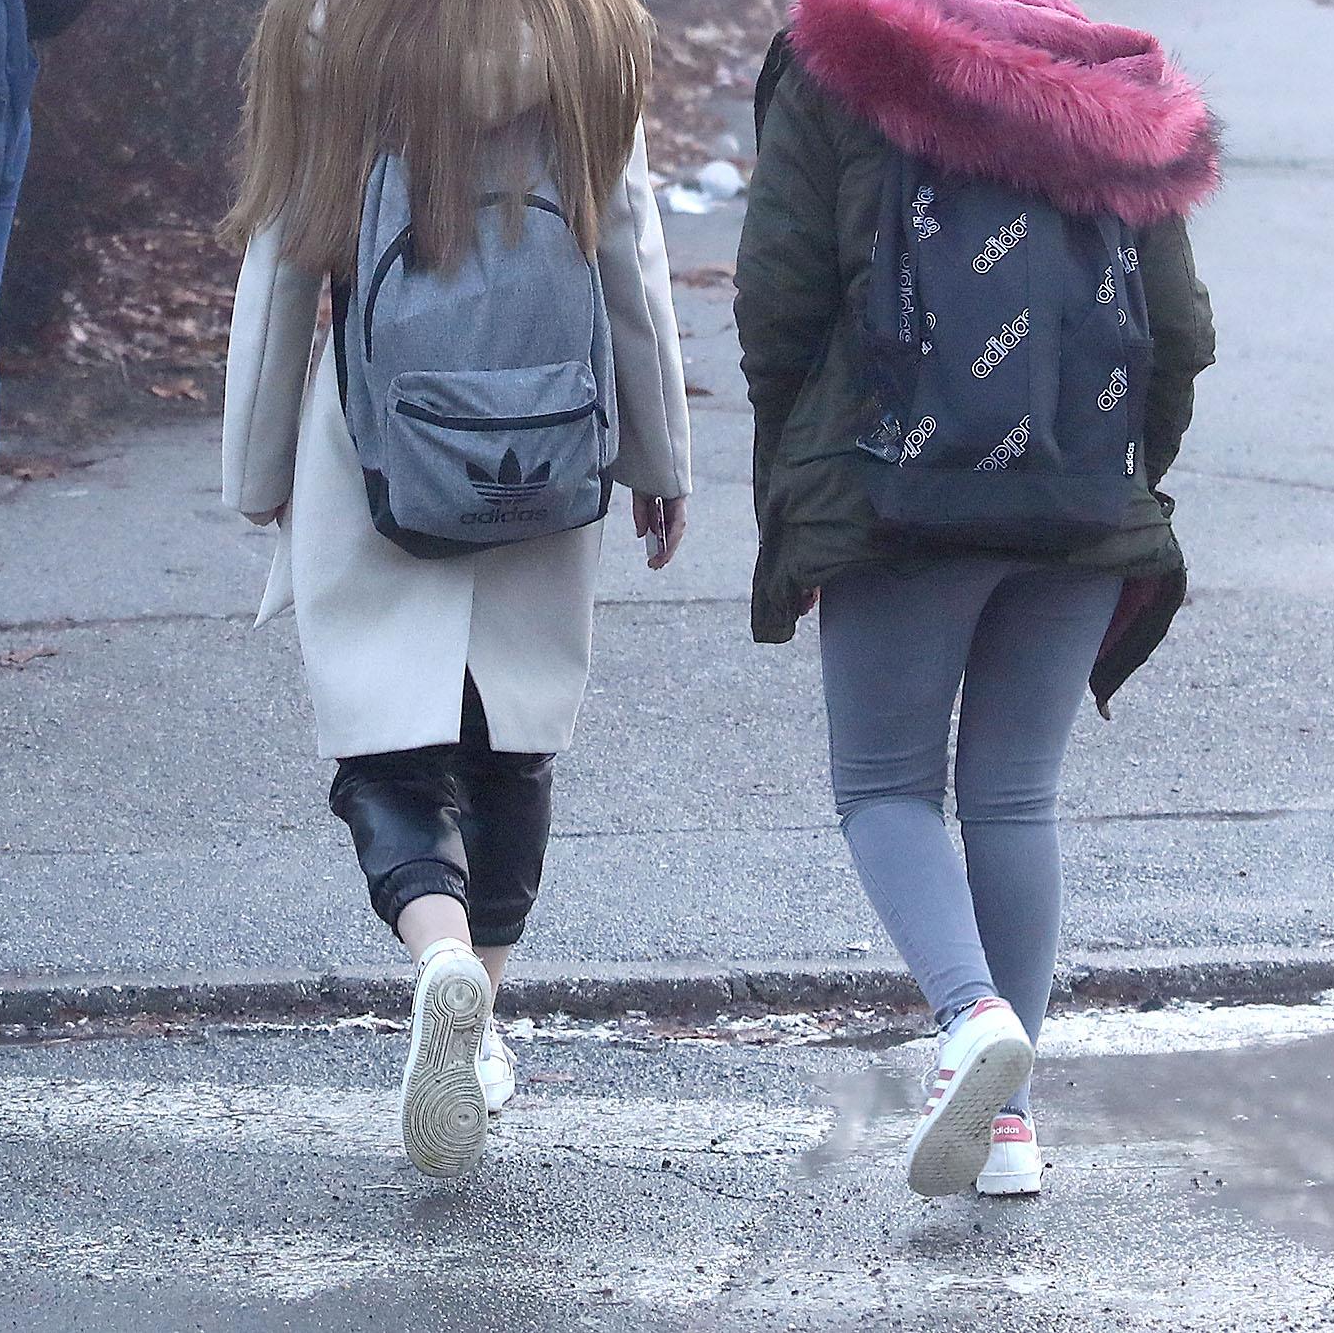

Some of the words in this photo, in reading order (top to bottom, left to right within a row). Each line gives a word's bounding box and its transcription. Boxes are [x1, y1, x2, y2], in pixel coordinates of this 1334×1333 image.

[972, 212, 1027, 274] adida
[1097, 365, 1128, 412] adi
[974, 414, 1030, 470] dida
[1126, 442, 1135, 475] adidas
[459, 505, 548, 524] adidas
